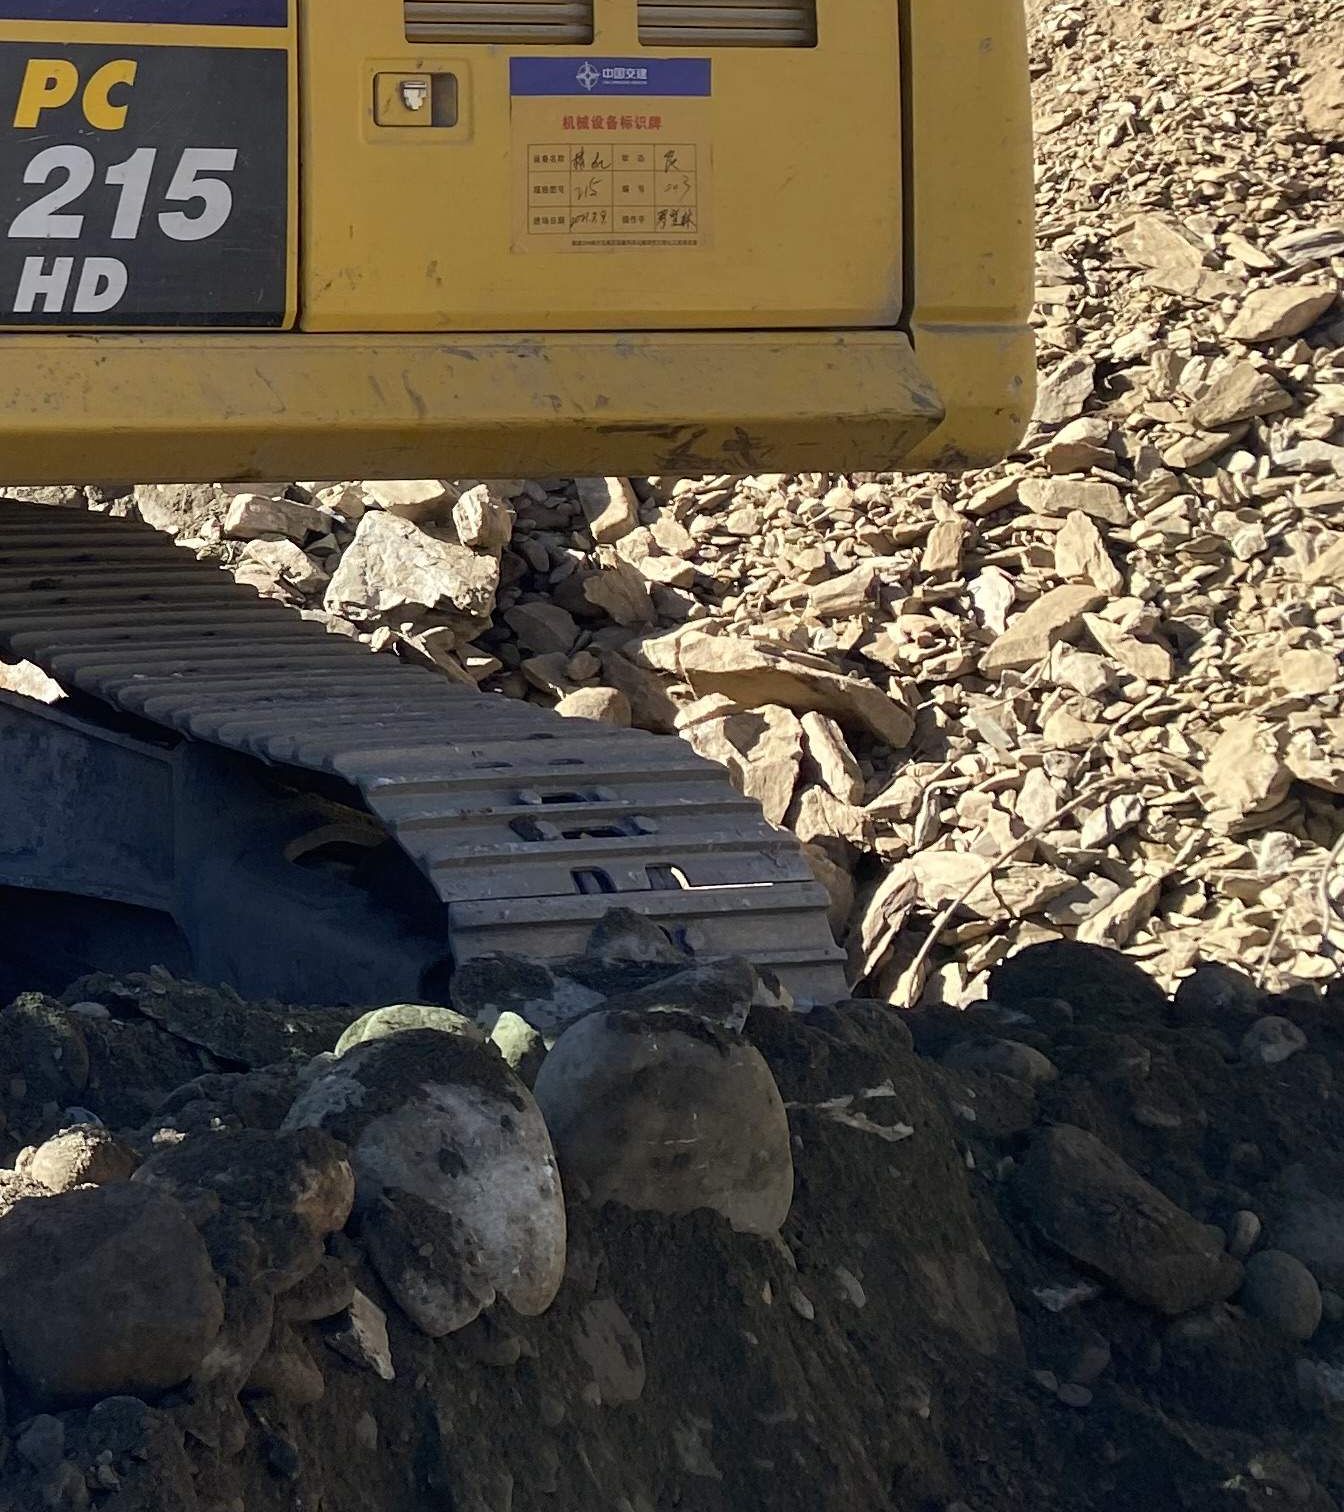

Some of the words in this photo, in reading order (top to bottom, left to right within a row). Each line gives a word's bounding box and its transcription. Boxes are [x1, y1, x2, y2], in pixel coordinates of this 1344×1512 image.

[13, 59, 138, 130] PC
[602, 68, 648, 80] 中国交建
[562, 115, 662, 130] 机械设备标识牌
[7, 144, 238, 241] 215
[13, 256, 128, 313] HD
